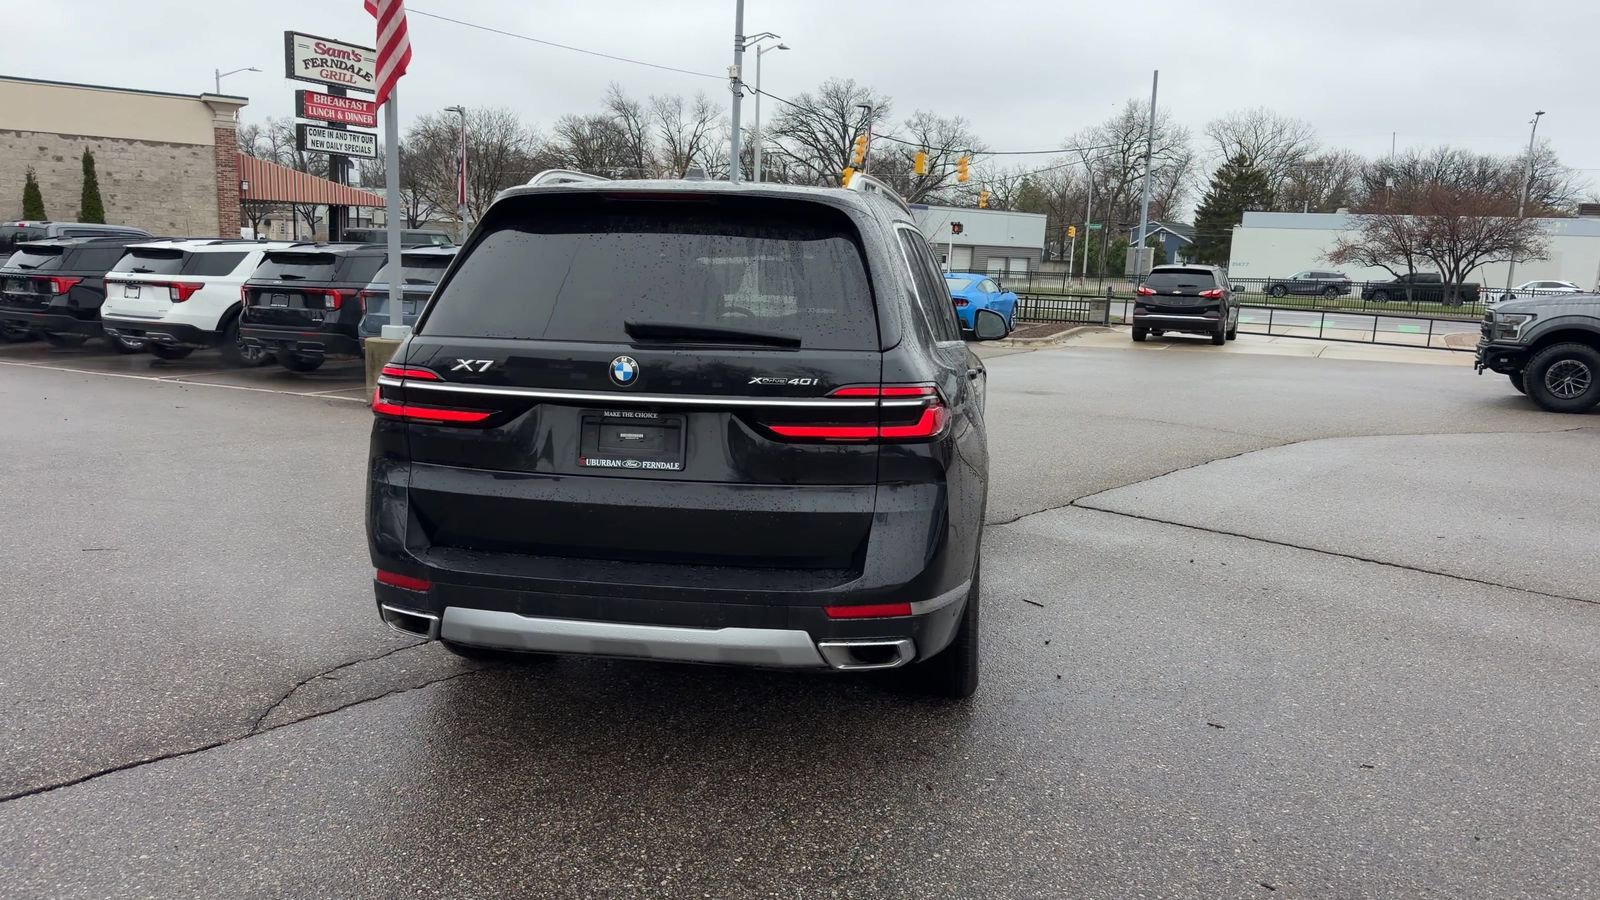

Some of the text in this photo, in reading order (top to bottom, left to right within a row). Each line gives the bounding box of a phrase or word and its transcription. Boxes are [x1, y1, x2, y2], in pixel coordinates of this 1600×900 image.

[314, 42, 362, 63] Sam's
[302, 58, 373, 82] FERNDALE
[320, 68, 357, 84] GRILL
[313, 94, 368, 111] BREAKFAST
[308, 106, 373, 124] LUNCH & DINNER
[309, 128, 373, 144] COME IN AND TRY OUR
[311, 139, 372, 154] NEW DAILY SPECIALS
[451, 358, 495, 373] X7
[642, 461, 680, 469] FERNDALE
